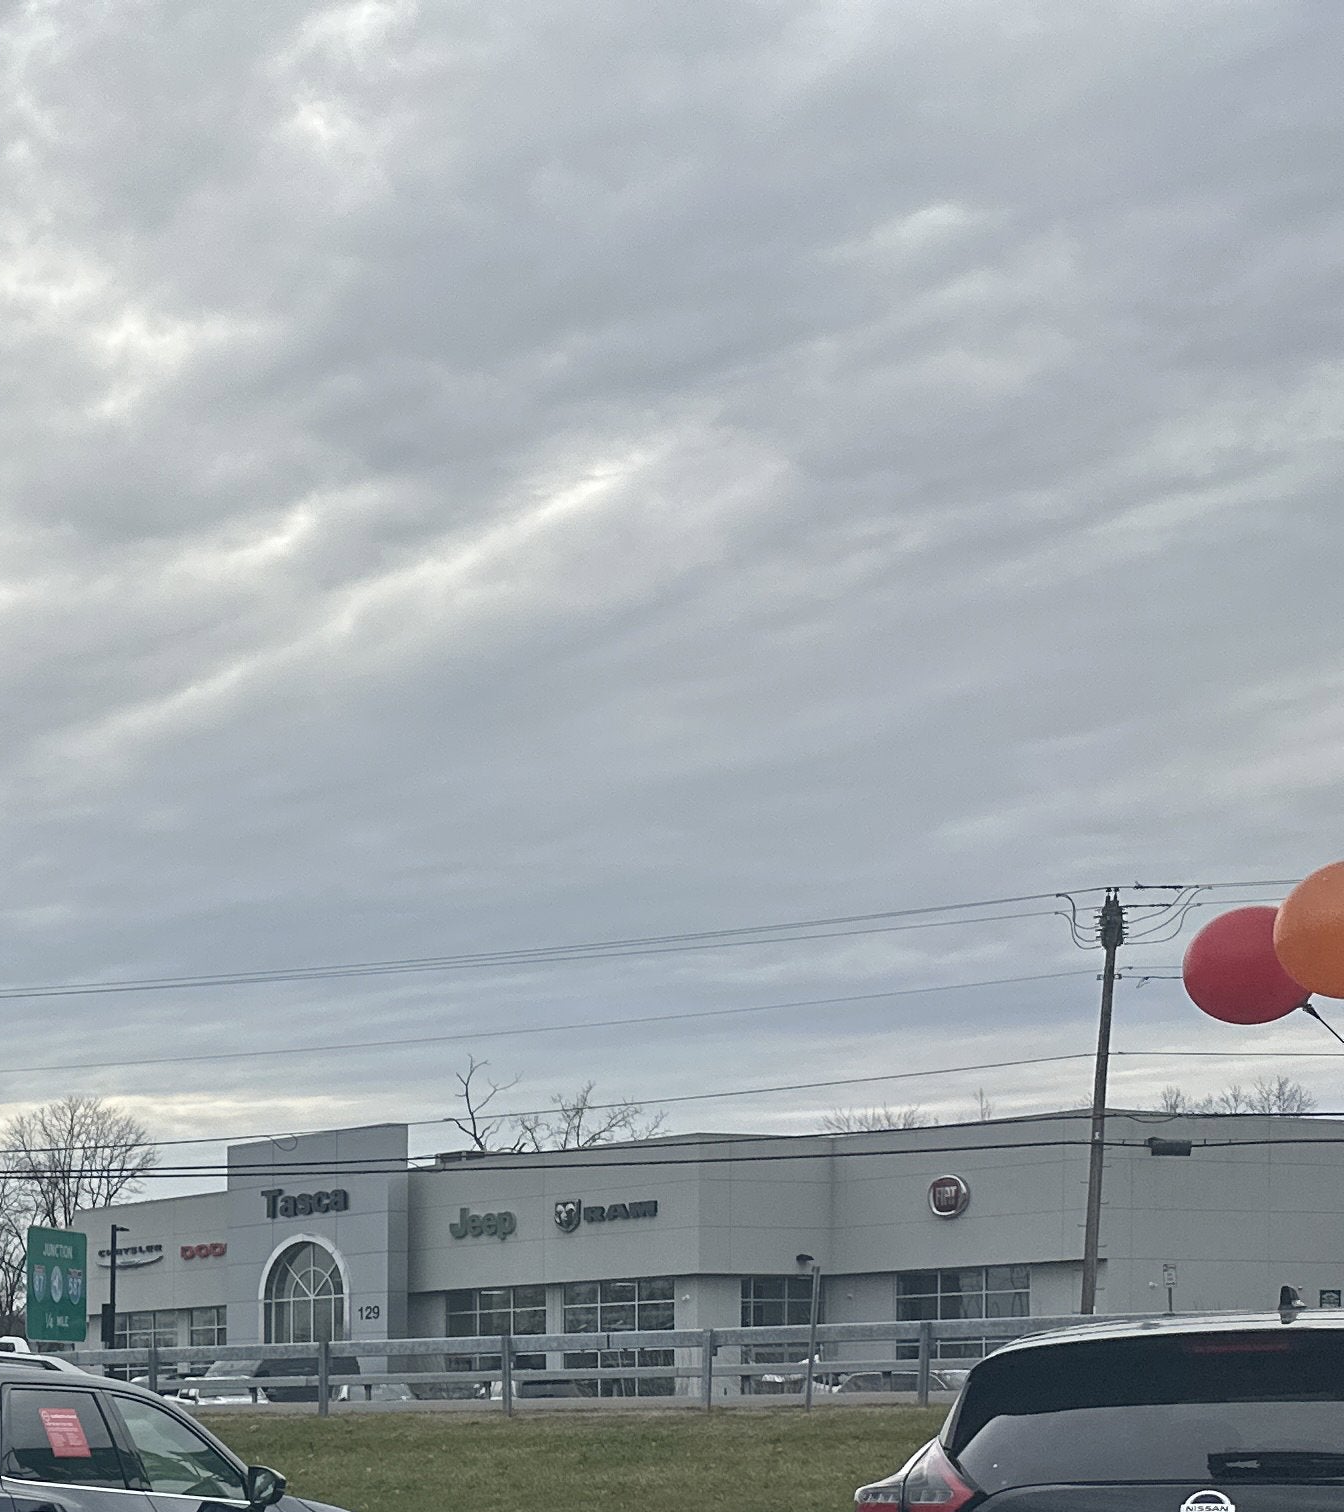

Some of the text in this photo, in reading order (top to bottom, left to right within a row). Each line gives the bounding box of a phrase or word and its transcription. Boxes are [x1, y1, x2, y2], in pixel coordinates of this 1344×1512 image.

[261, 1188, 349, 1220] Tasca
[935, 1185, 958, 1206] FIAT
[583, 1200, 658, 1223] RAM
[449, 1207, 517, 1241] Jeep
[42, 1243, 73, 1260] JUNCTION
[180, 1242, 227, 1260] DOD
[56, 1315, 70, 1328] MILE
[358, 1305, 380, 1321] 129
[1185, 1504, 1230, 1512] NISSAN
